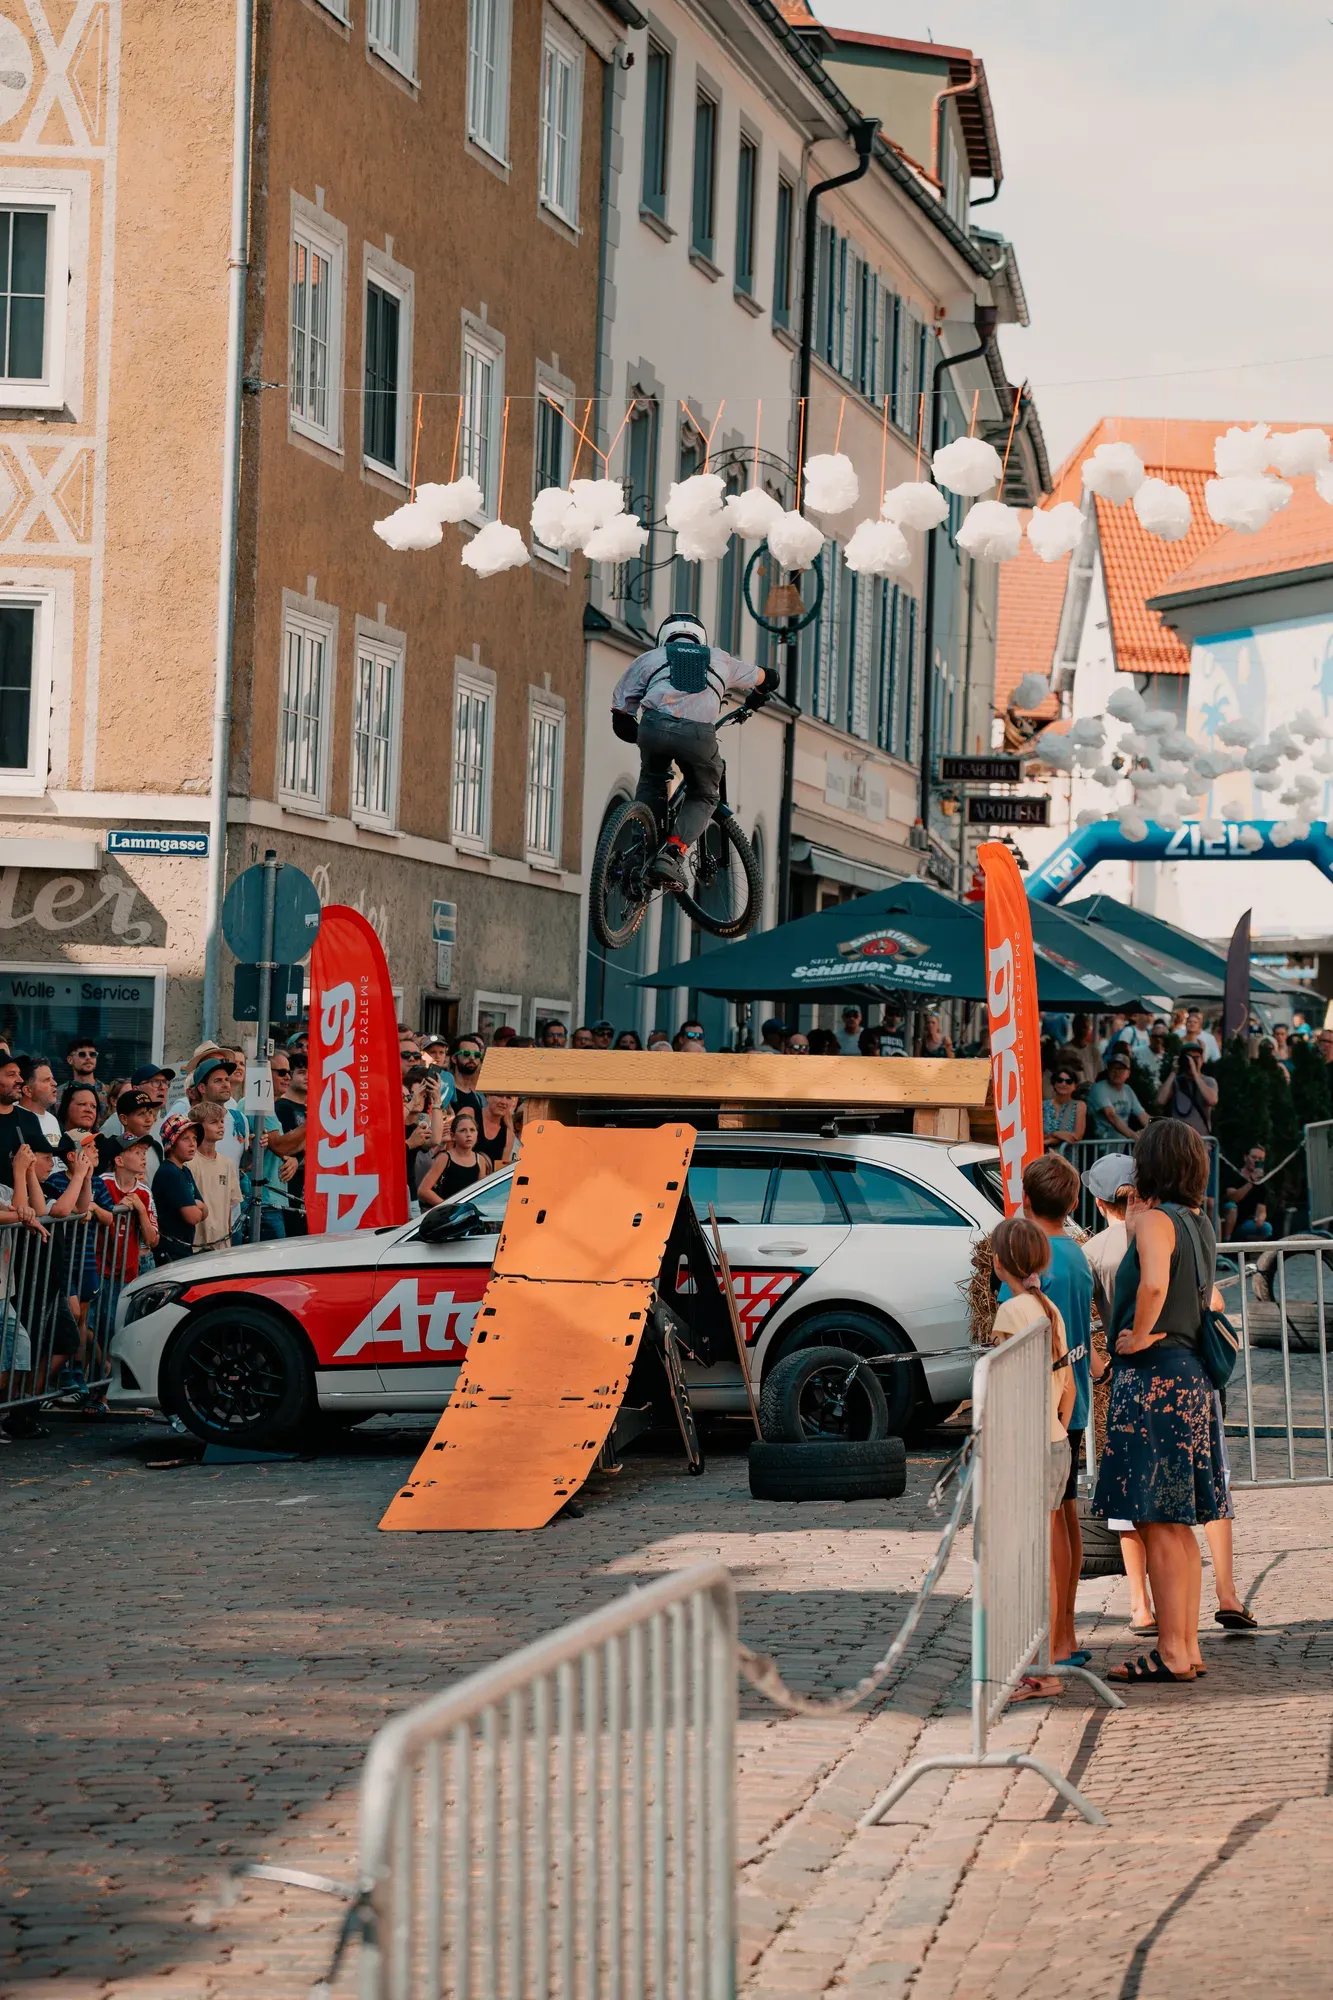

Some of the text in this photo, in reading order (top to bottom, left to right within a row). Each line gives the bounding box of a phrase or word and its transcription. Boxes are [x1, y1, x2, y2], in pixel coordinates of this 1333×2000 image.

[111, 833, 206, 852] Lammgasse
[1164, 824, 1251, 855] ZIEL
[791, 961, 953, 983] Schäffler Bräu
[11, 980, 140, 1001] Wolle Service
[253, 1079, 272, 1098] 17
